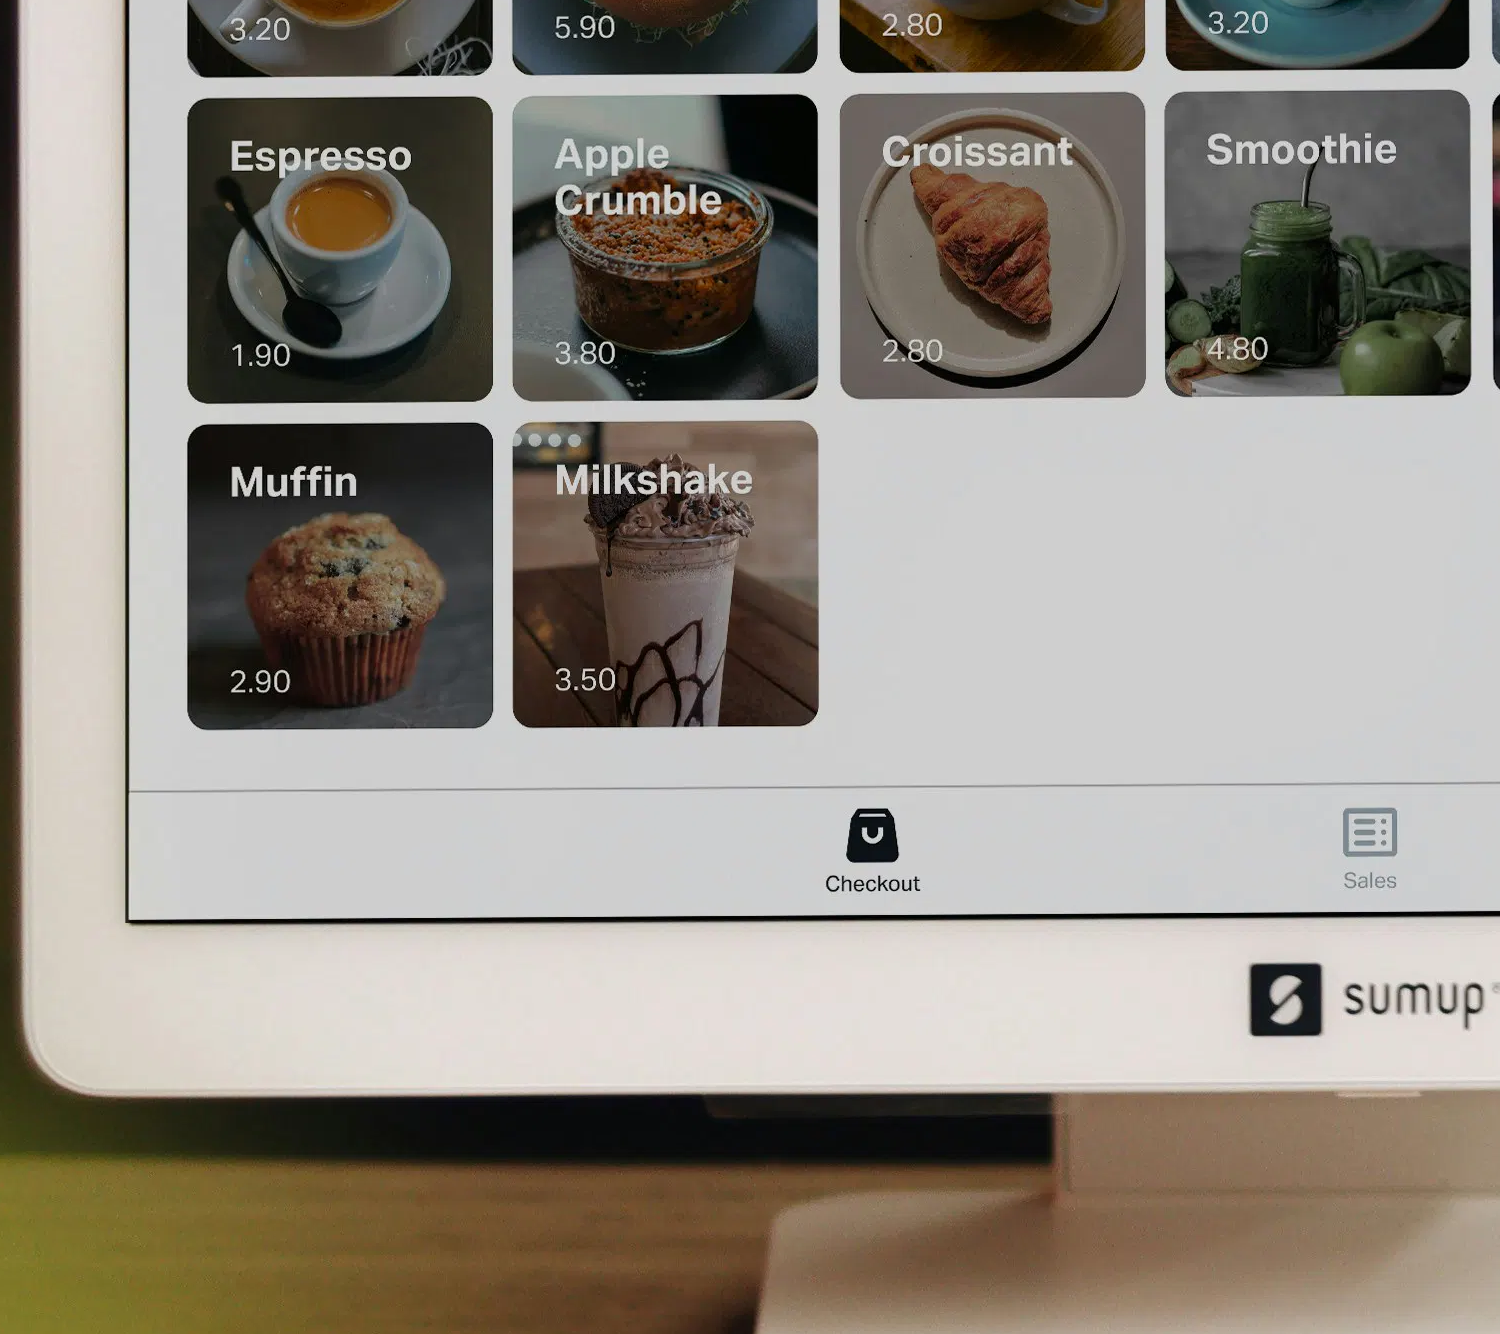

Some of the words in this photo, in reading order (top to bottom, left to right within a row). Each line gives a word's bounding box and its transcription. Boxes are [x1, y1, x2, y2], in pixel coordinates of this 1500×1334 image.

[229, 16, 291, 42] 3.20
[554, 14, 616, 40] 5.90
[881, 11, 943, 38] 2.80
[1207, 9, 1270, 36] 3.20
[230, 140, 412, 178] Espresso
[554, 138, 670, 176] Apple
[882, 135, 1074, 168] Croissant
[1206, 132, 1398, 165] Smoothie
[555, 184, 722, 216] Crumble
[231, 343, 291, 368] 1.90
[554, 341, 616, 366] 3.80
[881, 338, 944, 364] 2.80
[1207, 336, 1269, 362] 4.80
[230, 465, 357, 499] Muffin
[556, 463, 754, 496] Milkshake
[229, 669, 291, 695] 2.90
[554, 667, 617, 693] 3.50
[824, 872, 922, 895] Checkout
[1342, 870, 1398, 891] Sales
